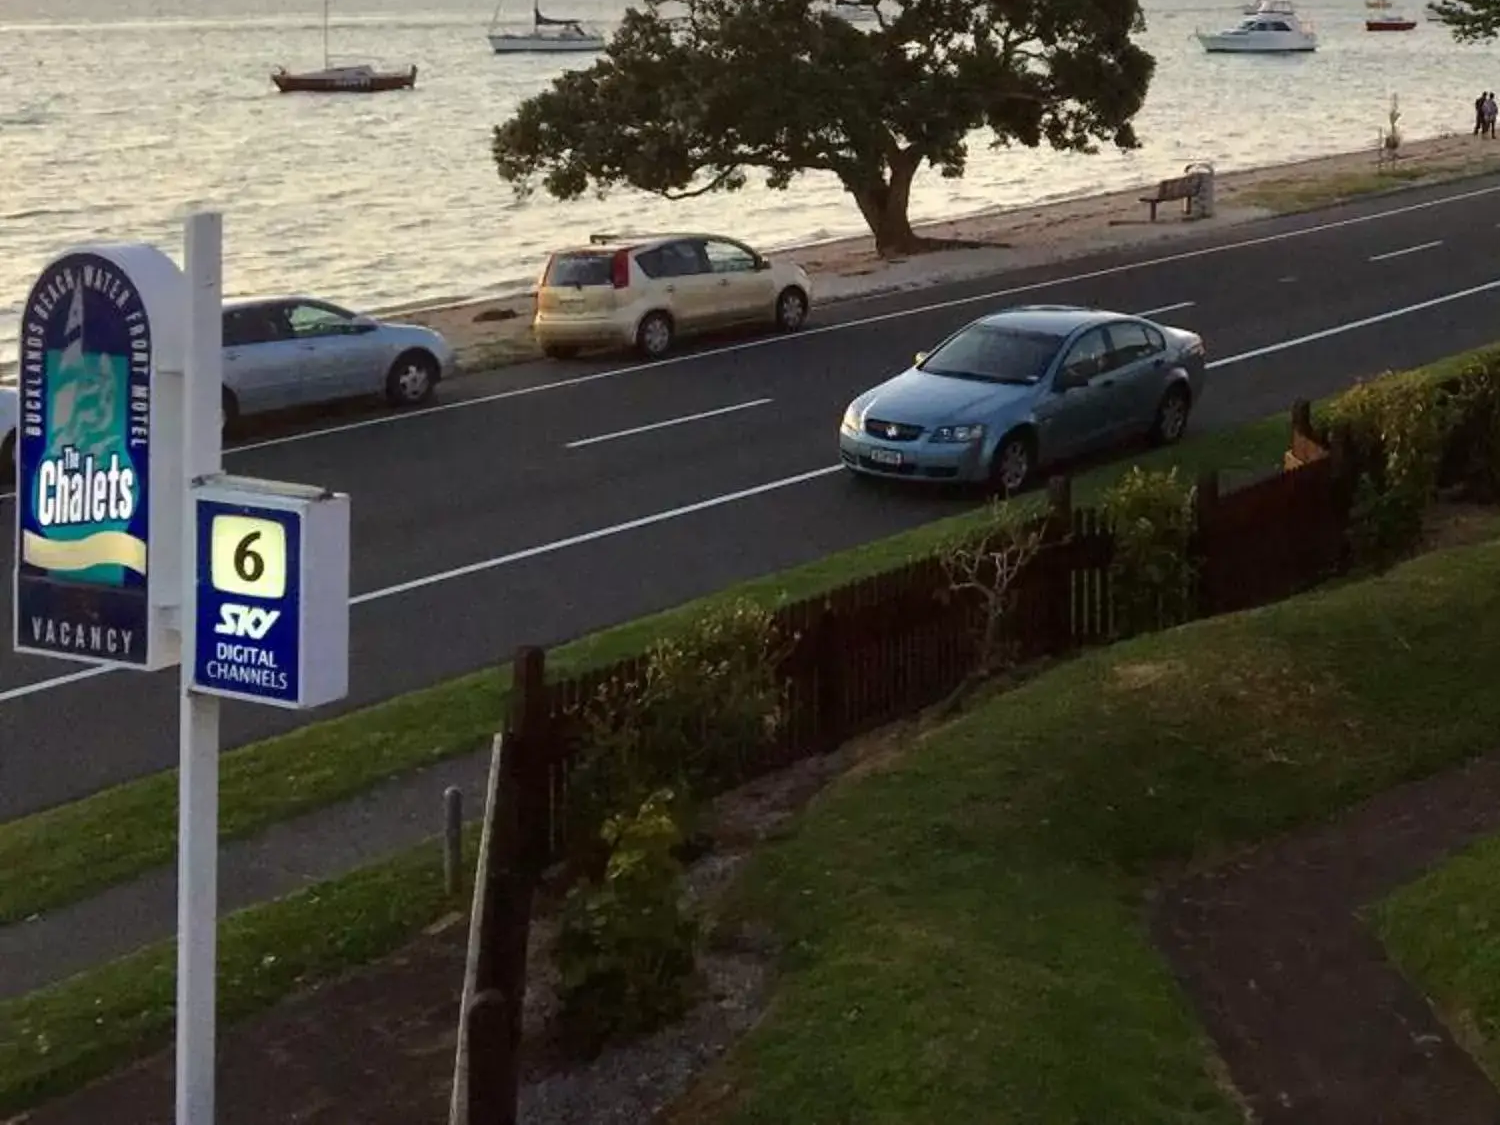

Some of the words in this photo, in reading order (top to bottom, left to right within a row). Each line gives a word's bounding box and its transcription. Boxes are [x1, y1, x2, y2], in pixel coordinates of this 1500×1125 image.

[33, 268, 74, 320] BEACH
[131, 386, 149, 446] MOTEL
[64, 447, 80, 469] The
[39, 454, 133, 526] Chalets
[233, 531, 264, 582] 6
[31, 616, 133, 654] VACANCY
[214, 603, 280, 639] SKY
[216, 642, 278, 668] DIGITAL
[206, 660, 288, 690] CHANNELS
